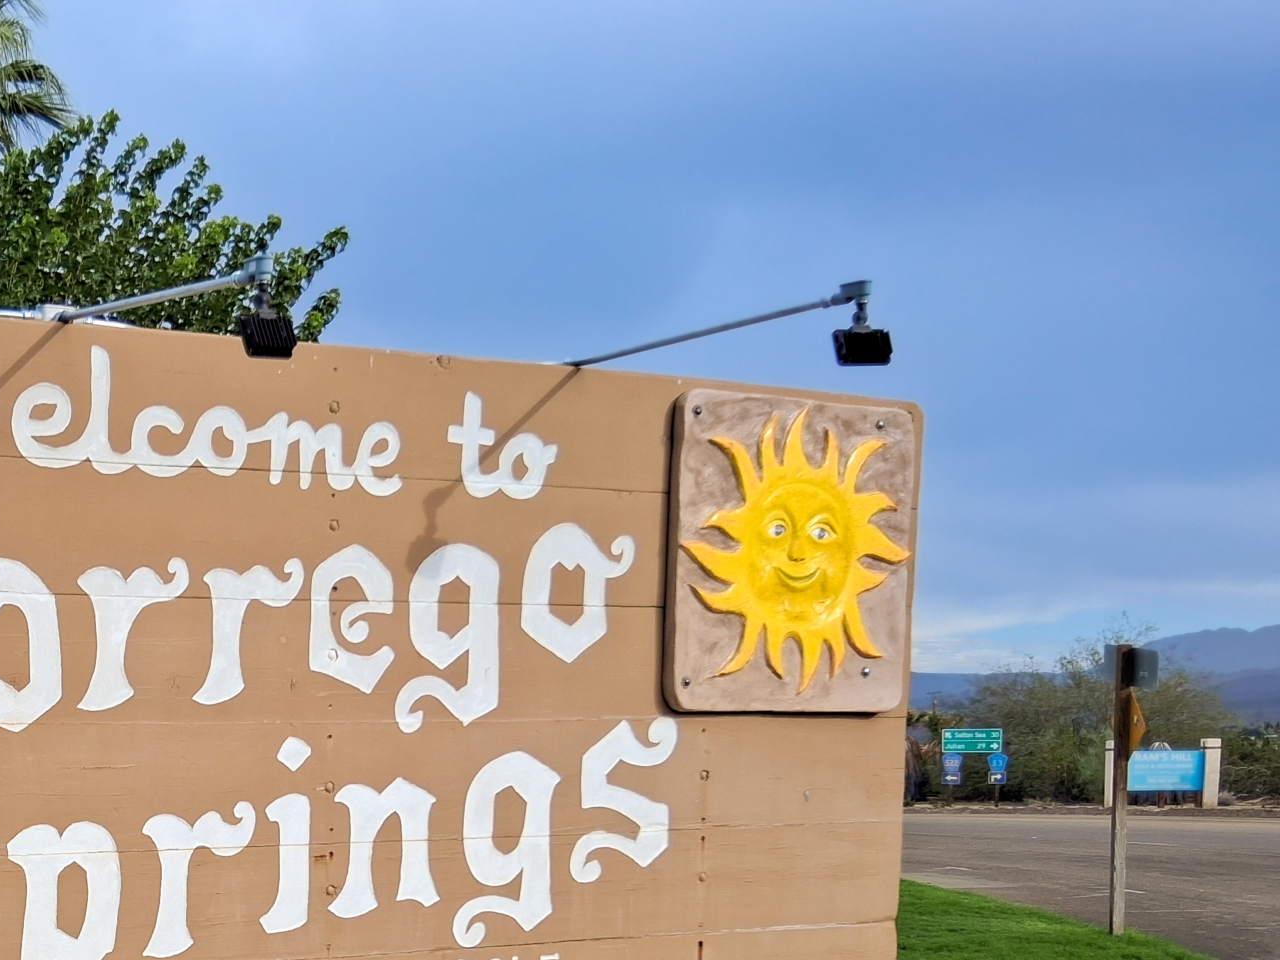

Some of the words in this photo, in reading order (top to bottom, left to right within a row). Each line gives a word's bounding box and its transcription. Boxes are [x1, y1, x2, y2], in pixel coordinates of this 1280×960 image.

[446, 389, 562, 501] to
[976, 742, 986, 750] 29
[1171, 752, 1193, 761] HILL
